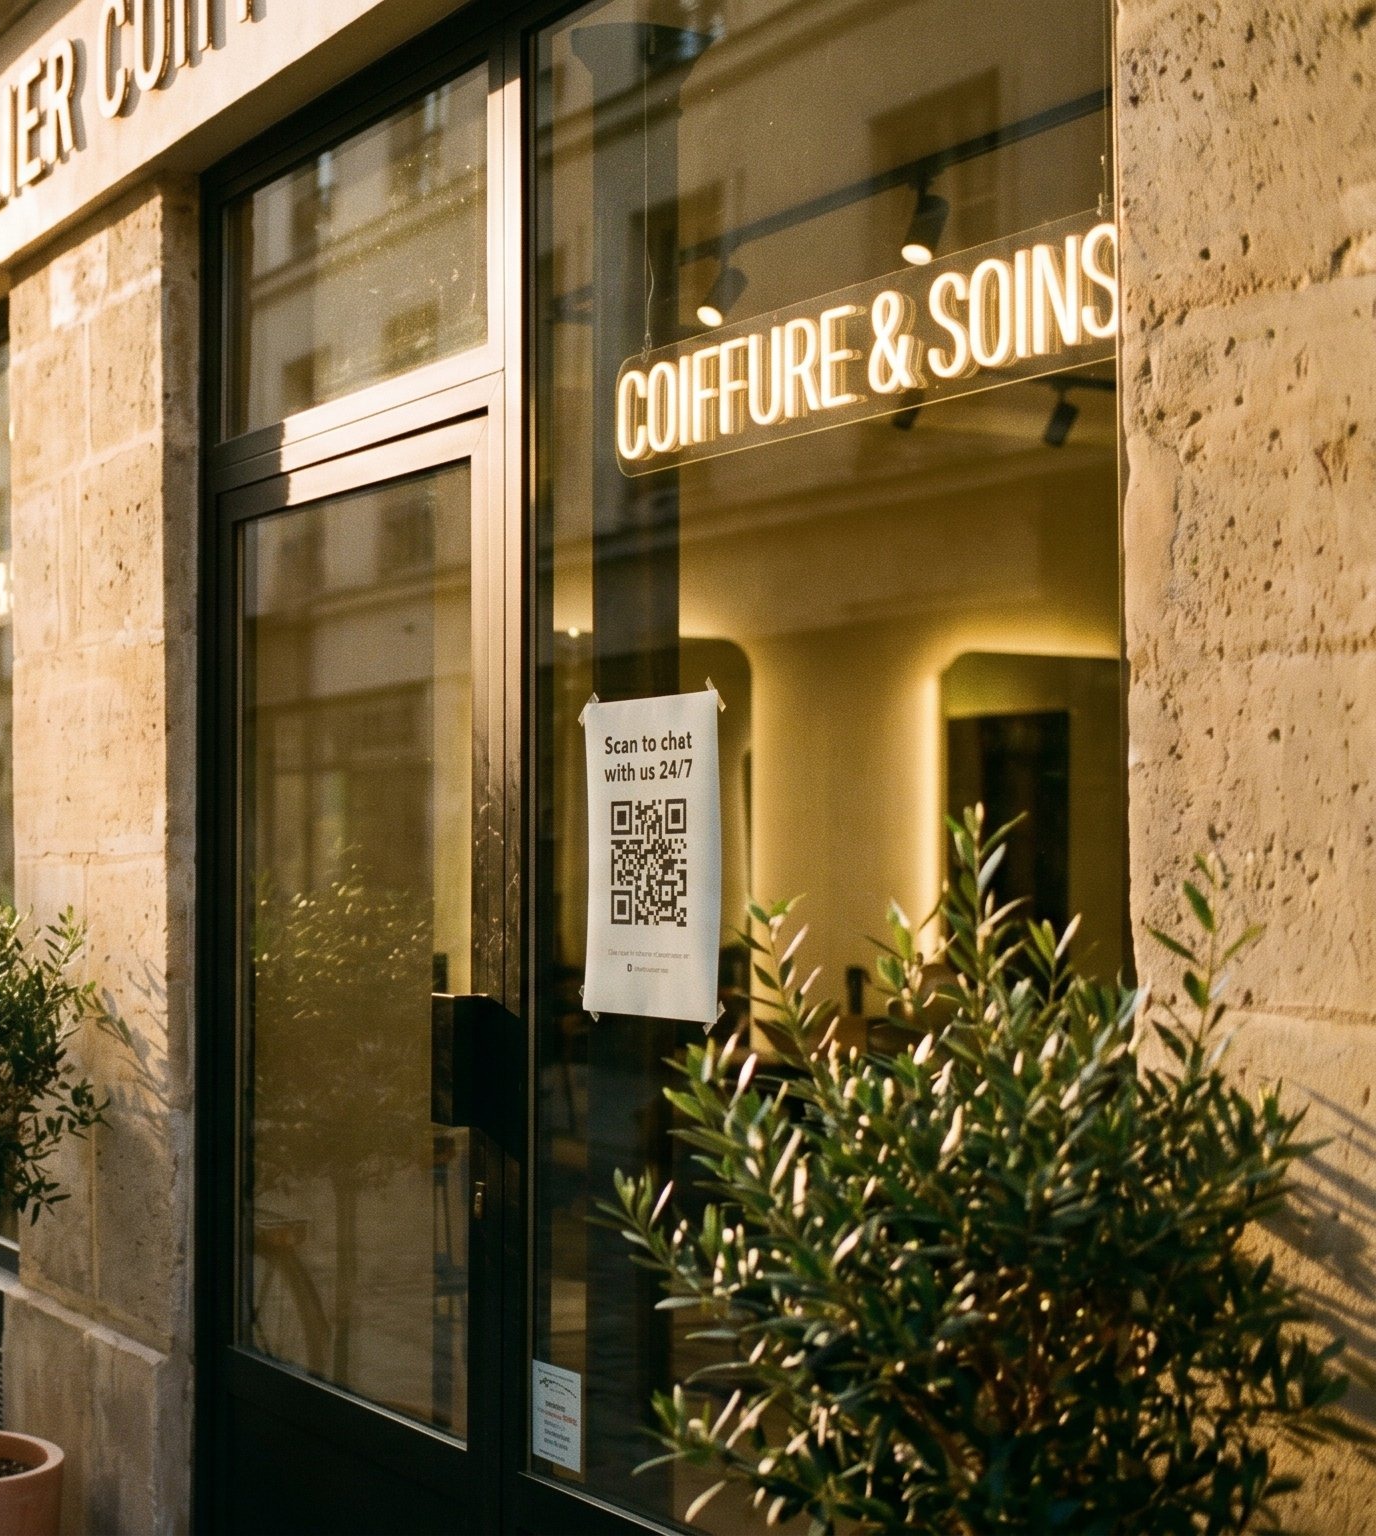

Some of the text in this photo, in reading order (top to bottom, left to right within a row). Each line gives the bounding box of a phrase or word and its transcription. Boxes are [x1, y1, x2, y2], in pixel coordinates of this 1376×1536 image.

[618, 223, 1117, 460] COIFFURE & SOINS
[604, 730, 693, 755] Scan to chat
[604, 758, 693, 782] with us 24/7
